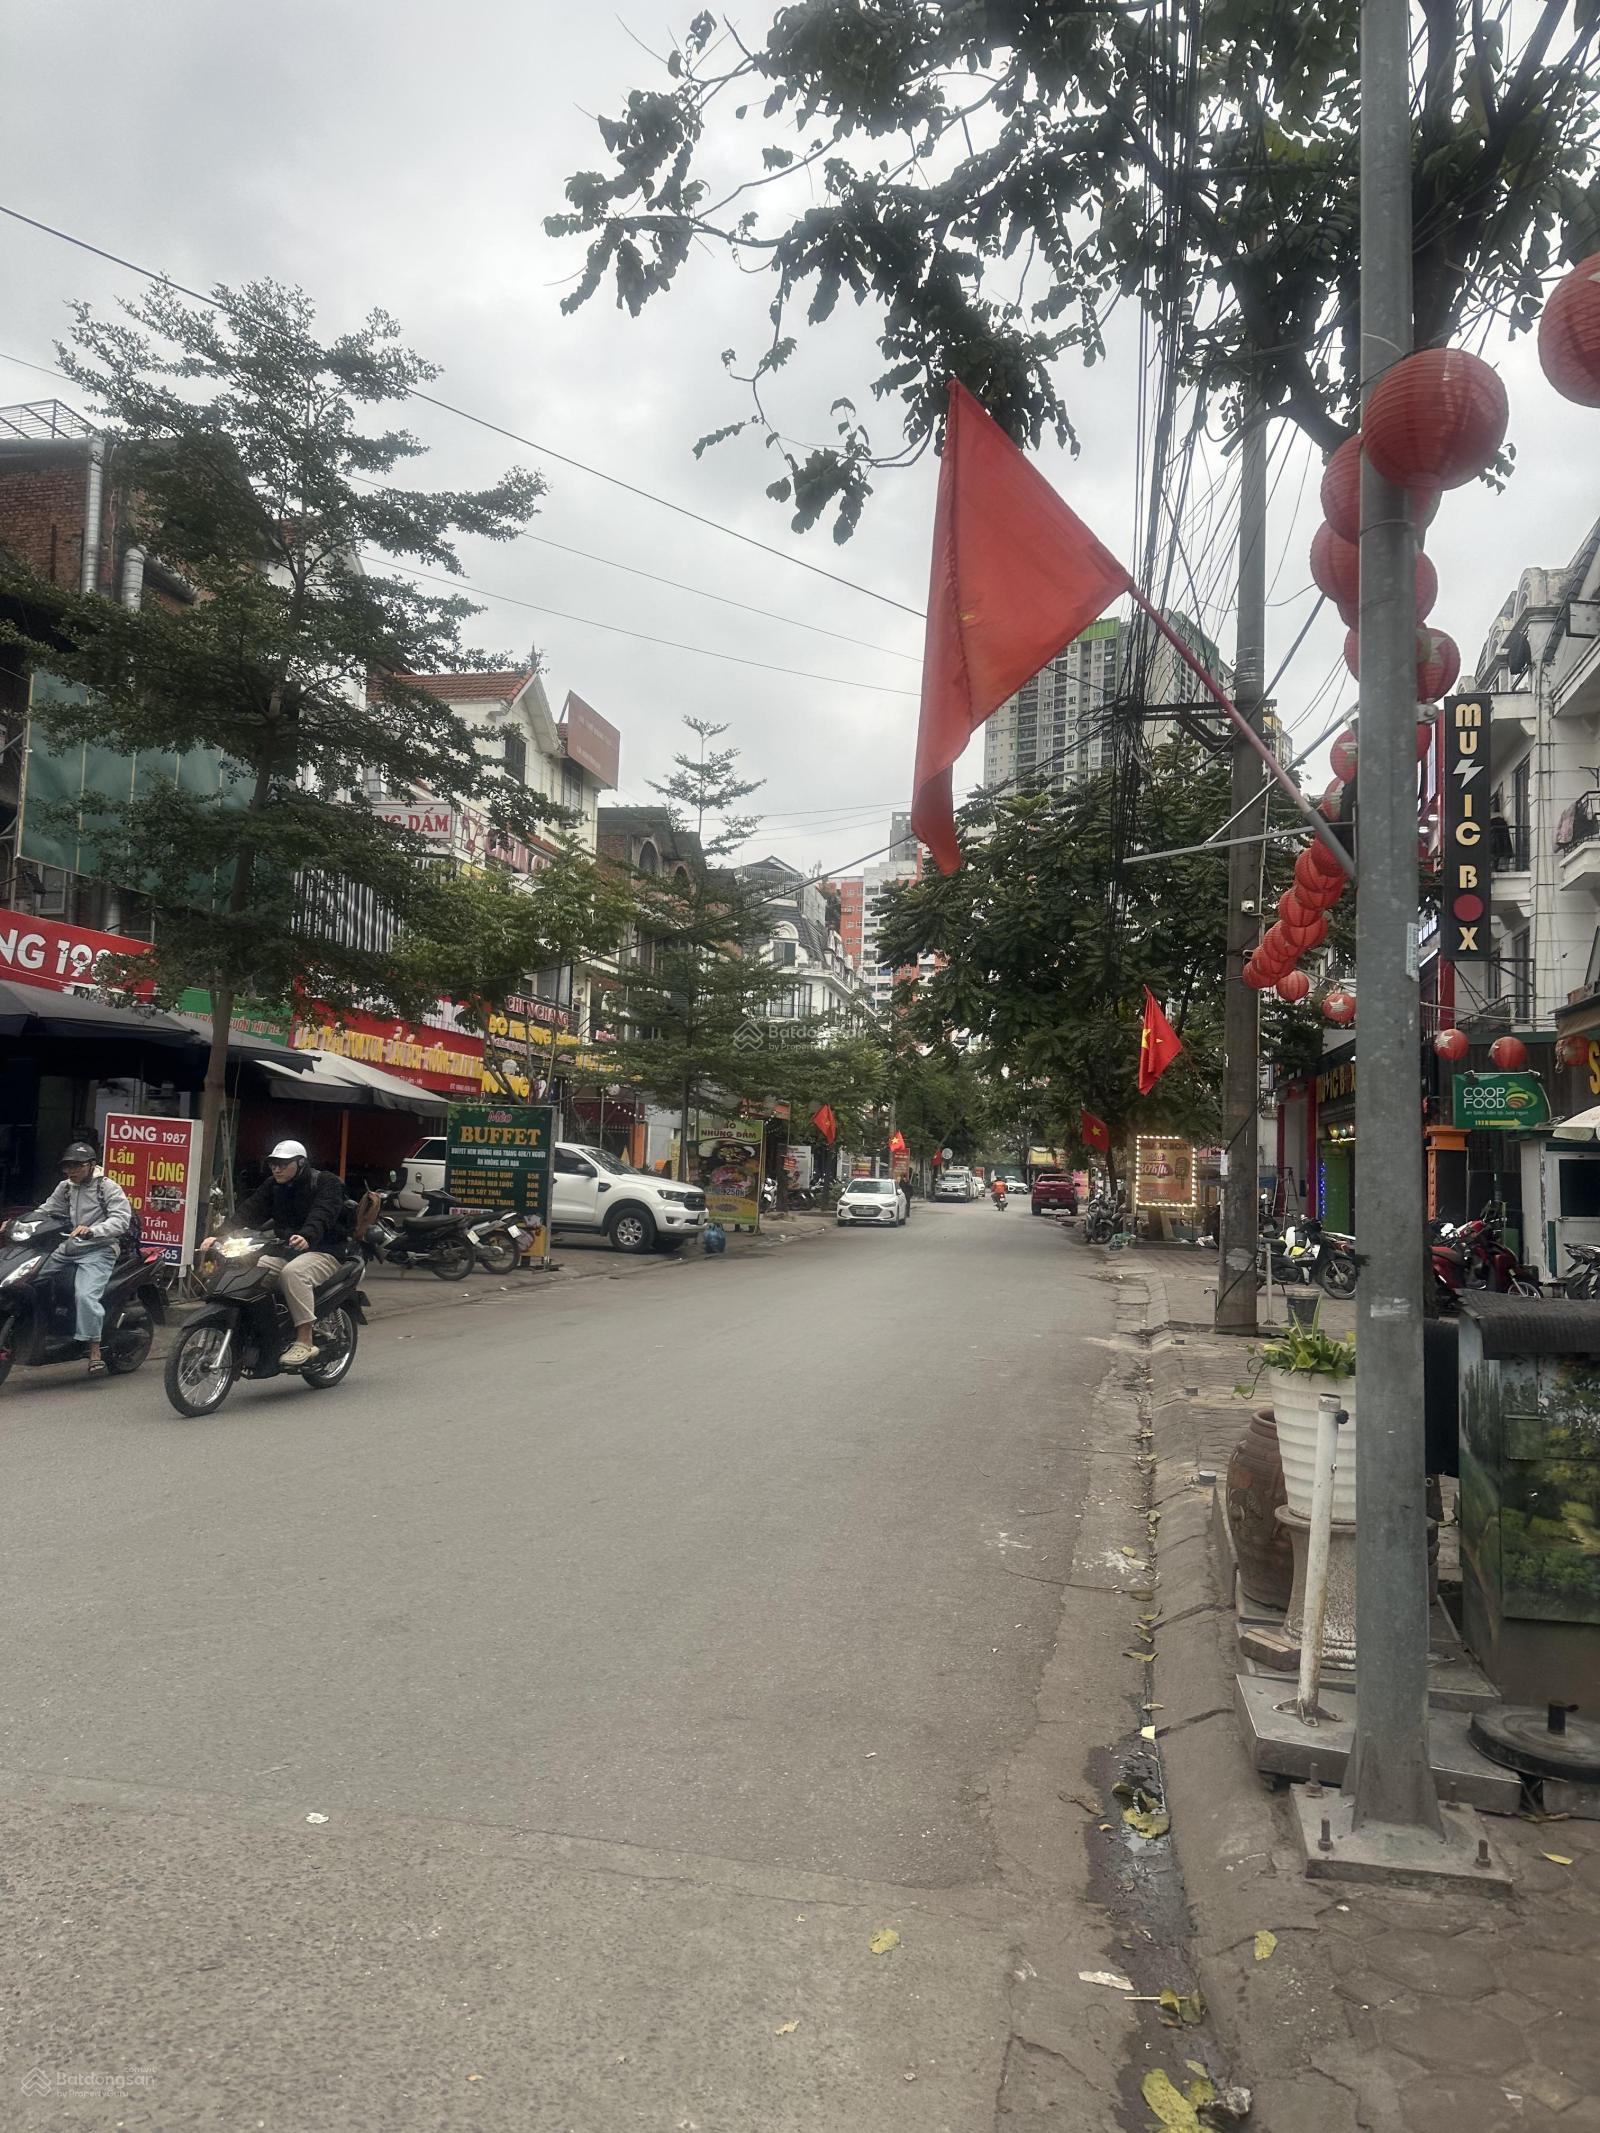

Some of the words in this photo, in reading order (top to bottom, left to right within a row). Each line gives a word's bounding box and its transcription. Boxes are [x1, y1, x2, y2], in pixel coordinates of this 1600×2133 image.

[1463, 1098, 1505, 1109] FOOD
[110, 1120, 157, 1142] LÒNG
[162, 1132, 187, 1144] 1987
[460, 1126, 541, 1146] BUFFET
[109, 1145, 135, 1165] Lẩu
[108, 1169, 135, 1187] Bún
[149, 1157, 185, 1183] LÒNG
[150, 1231, 180, 1244] Nhậu
